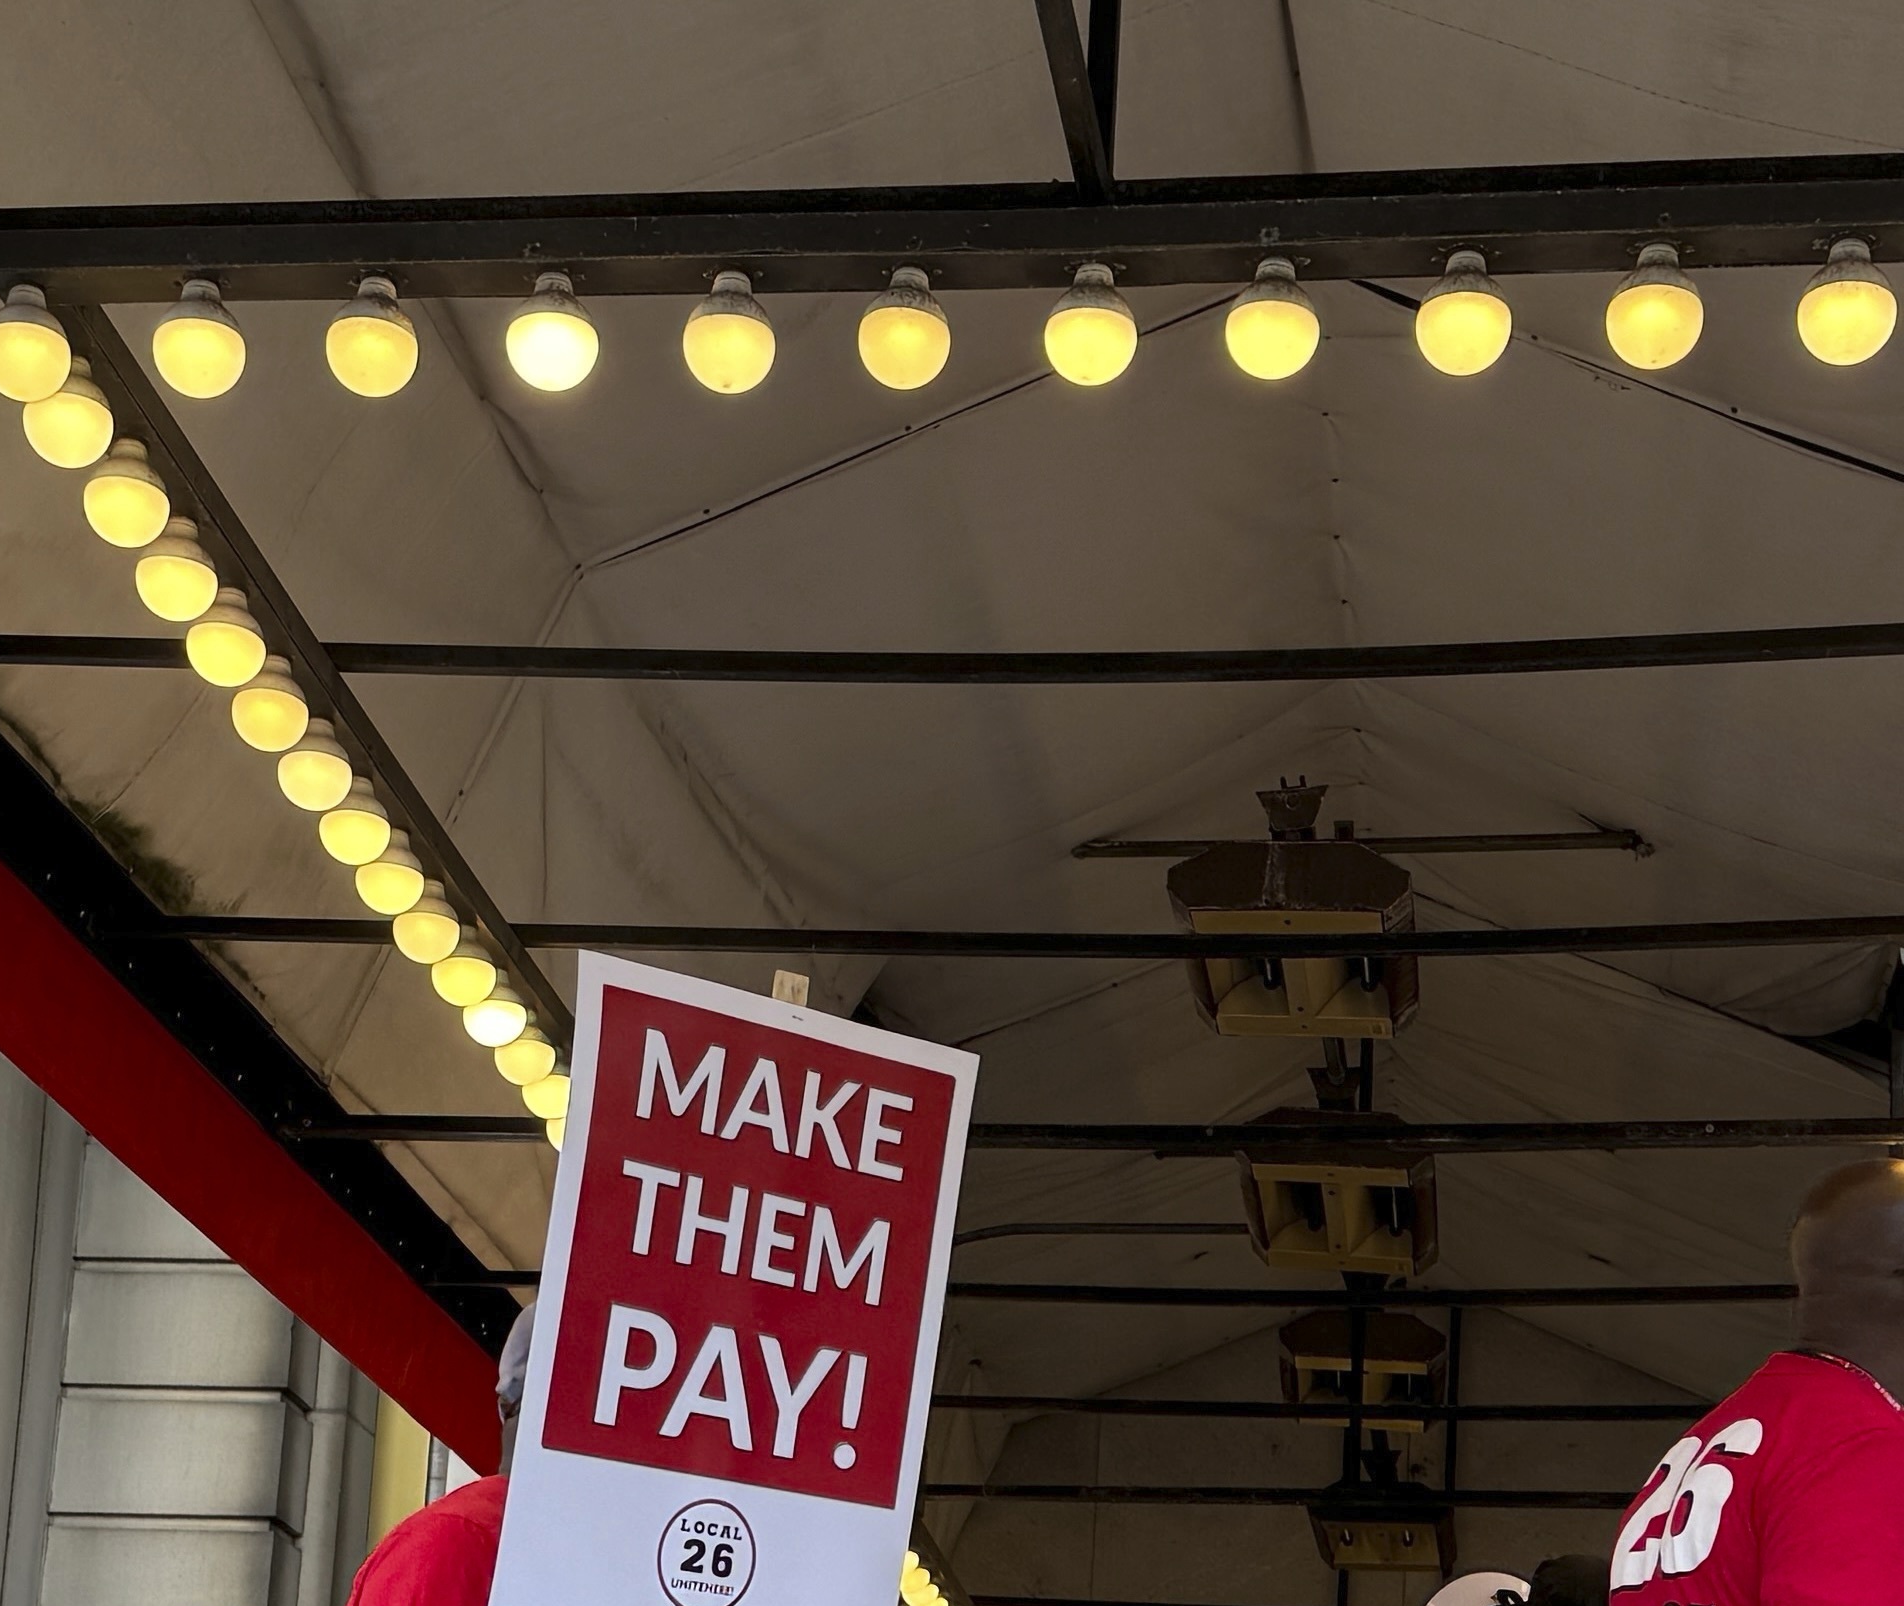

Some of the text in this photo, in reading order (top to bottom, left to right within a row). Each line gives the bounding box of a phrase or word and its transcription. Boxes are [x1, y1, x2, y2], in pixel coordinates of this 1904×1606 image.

[636, 1027, 913, 1181] MAKE
[622, 1159, 890, 1306] THEM
[594, 1304, 867, 1470] PAY!
[680, 1518, 742, 1541] LOCAL
[680, 1538, 734, 1578] 26
[1610, 1418, 1763, 1592] 26
